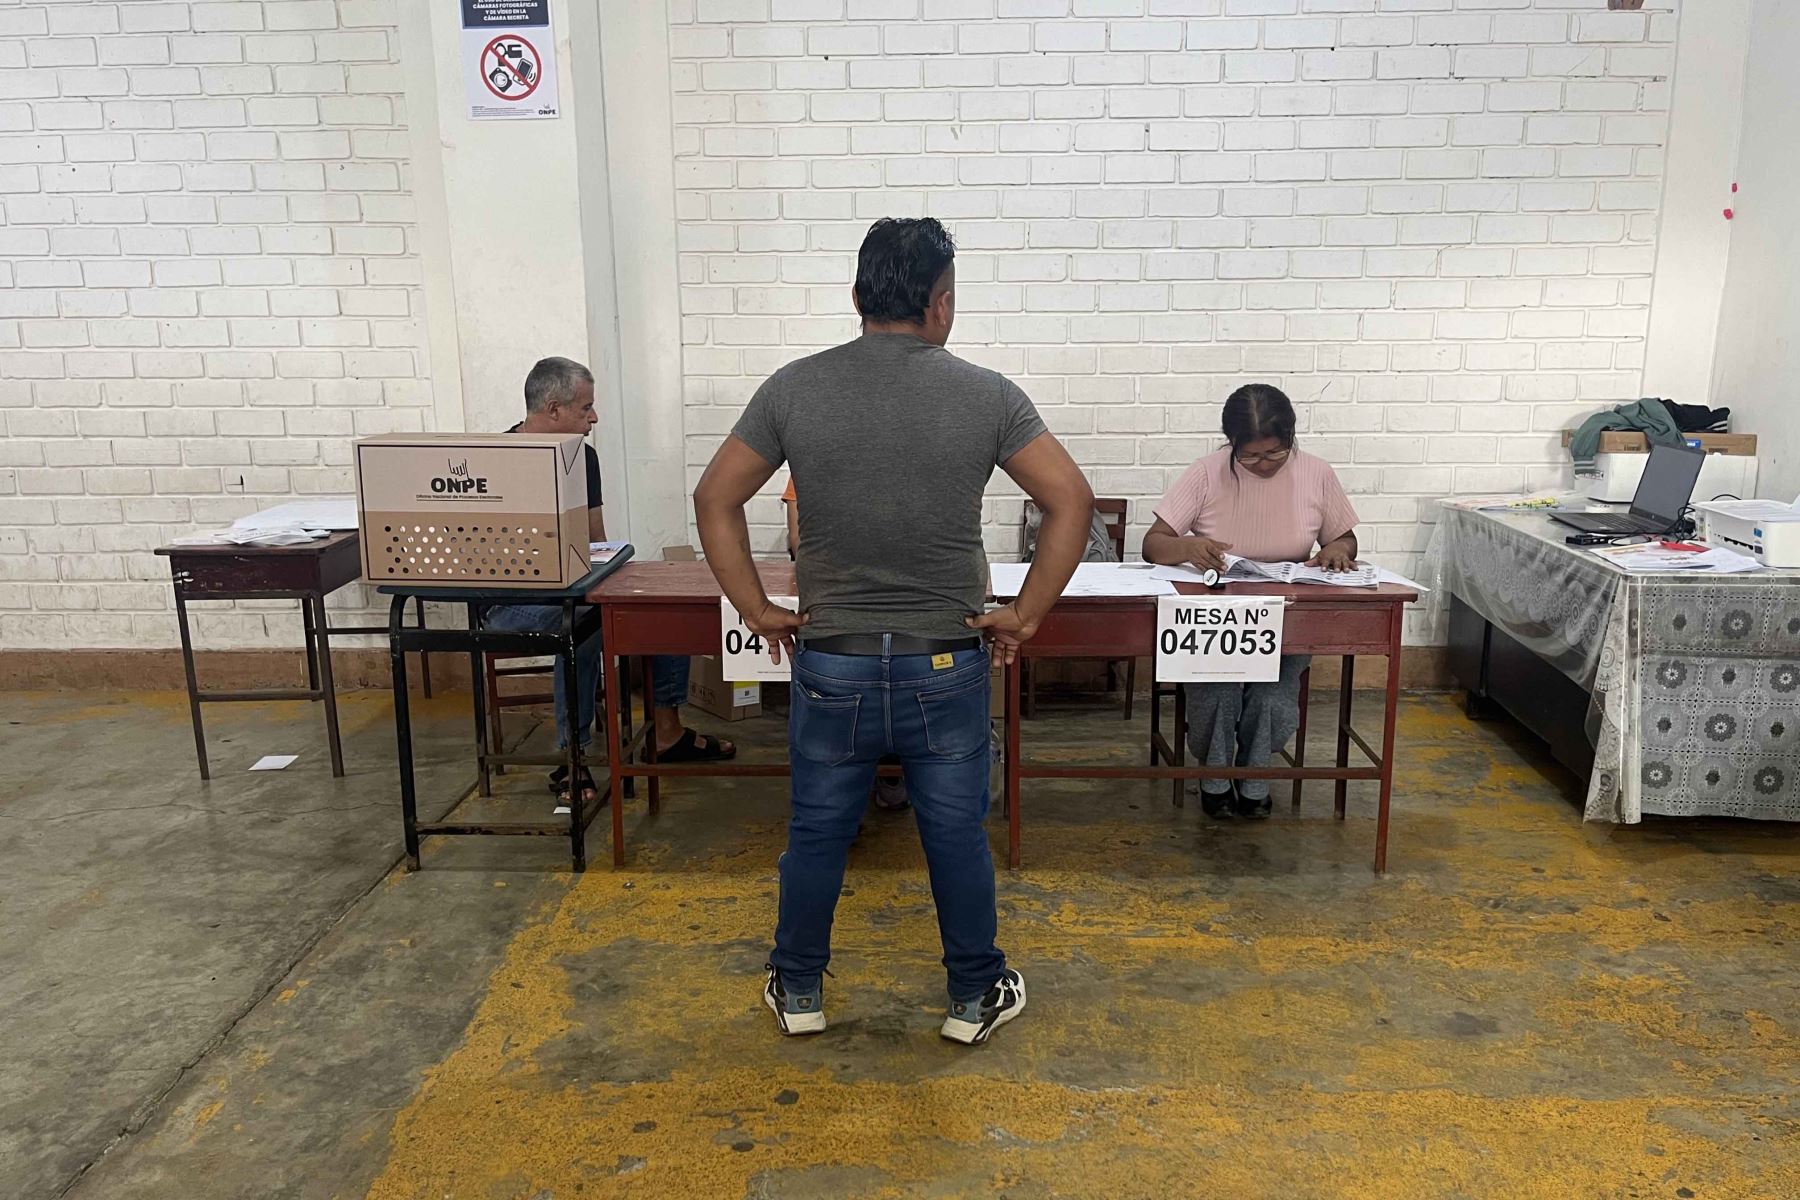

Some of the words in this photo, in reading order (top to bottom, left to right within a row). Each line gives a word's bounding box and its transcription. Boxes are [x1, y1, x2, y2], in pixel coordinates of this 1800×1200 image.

[431, 477, 488, 493] ONPE
[1175, 608, 1238, 625] MESA
[1160, 629, 1276, 655] 047053
